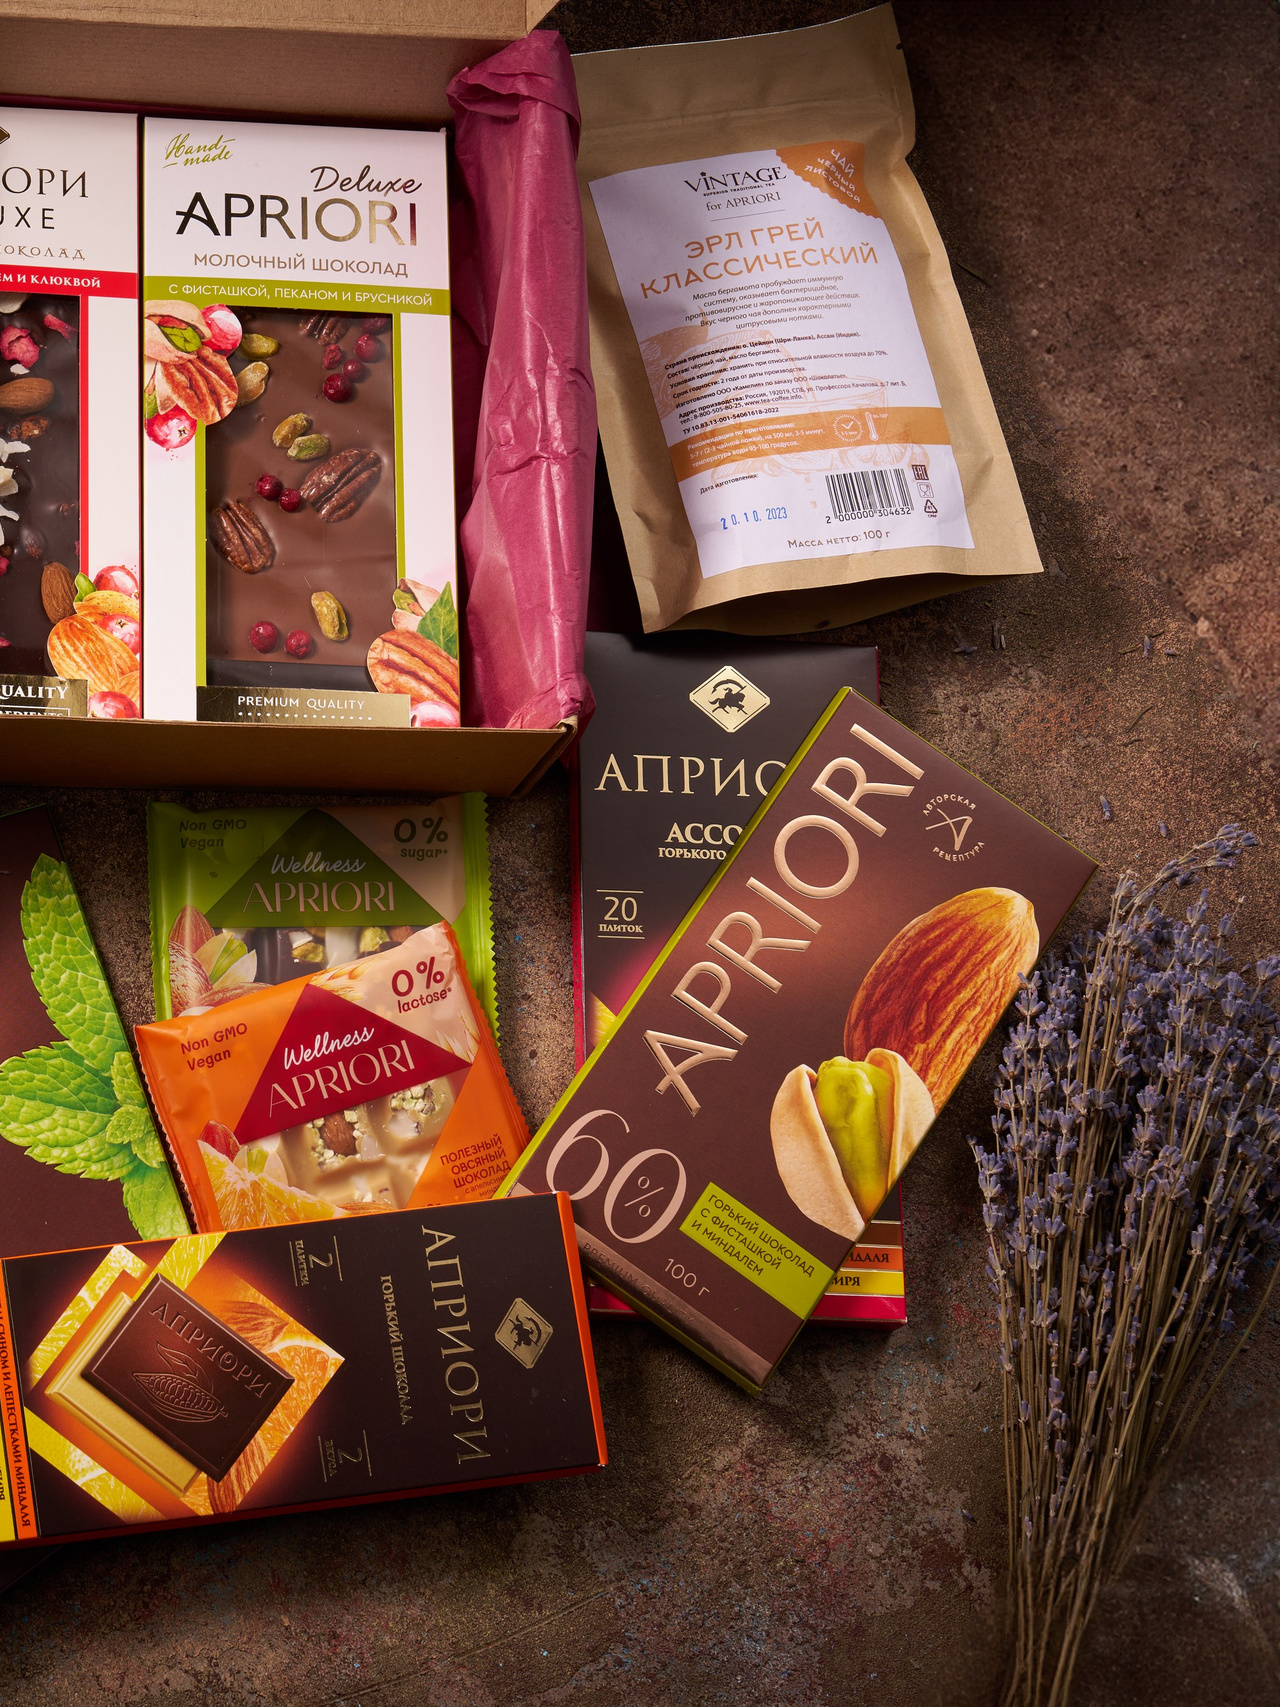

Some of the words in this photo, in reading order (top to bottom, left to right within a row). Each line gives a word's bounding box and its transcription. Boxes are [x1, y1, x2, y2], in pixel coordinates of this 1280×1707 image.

[817, 157, 856, 192] ЧЕРНЫЙ
[830, 148, 855, 178] ЧАЙ
[310, 164, 423, 197] Deluxe
[683, 166, 787, 192] VINTAGE
[703, 189, 729, 197] SUPERIOR
[730, 184, 764, 193] TRADITIONAL
[804, 164, 861, 203] ЛИСТОВОЙ
[706, 201, 722, 211] for
[725, 191, 782, 209] APRIORI
[175, 191, 417, 247] APRIORI
[684, 231, 743, 259] ЭРЛ
[750, 217, 824, 246] ГРЕЙ
[194, 253, 306, 271] МОЛОЧНЫЙ
[312, 258, 409, 278] ШОКОЛАД
[640, 241, 878, 299] КЛАССИЧЕСКИЙ
[17, 273, 27, 283] И
[30, 274, 101, 288] КЛЮКВОЙ
[692, 289, 717, 301] Масло
[718, 283, 760, 297] бергамота
[760, 277, 806, 291] пробуждает
[168, 284, 178, 295] С
[182, 284, 271, 300] ФИСТАШКОЙ,
[274, 287, 338, 301] ПЕКАНОМ
[342, 290, 351, 301] И
[355, 291, 432, 306] БРУСНИКОЙ
[703, 296, 738, 308] систему,
[738, 290, 780, 301] оказывает
[685, 302, 752, 322] противовирусное
[700, 318, 717, 328] Вкус
[717, 313, 748, 324] черного
[762, 305, 797, 316] дополнен
[735, 316, 788, 330] цитрусовыми
[789, 313, 824, 323] нотками.
[699, 484, 714, 495] Дата
[715, 473, 759, 488] изготовления:
[765, 506, 788, 520] 2023
[877, 507, 912, 518] 304632
[863, 529, 882, 540] 100
[238, 696, 299, 707] PREMIUM
[306, 698, 365, 711] QUALITY
[922, 793, 977, 816] АВТОРСКАЯ
[179, 819, 207, 833] Non
[212, 819, 247, 831] GMO
[180, 836, 224, 851] Vegan
[658, 847, 728, 861] ГОРЬКОГО
[932, 841, 985, 862] РЕЦЕПТУРА
[271, 851, 366, 875] Wellness
[242, 881, 395, 913] APRIORI
[603, 896, 638, 922] 20
[599, 924, 644, 933] ПЛИТОК
[641, 723, 925, 1117] APRIORI
[180, 1037, 209, 1055] Non
[213, 1022, 248, 1043] GMO
[283, 1026, 375, 1070] Wellness
[186, 1049, 232, 1072] Vegan
[269, 1039, 416, 1118] APRIORI
[440, 1133, 502, 1166] ПОЛЕЗНЫЙ
[451, 1146, 506, 1175] ОВСЯНЫЙ
[453, 1160, 511, 1189] ШОКОЛАД
[691, 1219, 701, 1231] И
[701, 1228, 764, 1276] МИНДАЛЕМ
[700, 1207, 711, 1219] С
[711, 1214, 782, 1271] ФИСТАШКОЙ
[708, 1194, 760, 1236] ГОРЬКИЙ
[758, 1231, 816, 1278] ШОКОЛАД
[295, 1239, 310, 1286] ПЛИТКИ
[309, 1252, 333, 1269] 2
[664, 1258, 697, 1288] 100
[584, 1242, 638, 1286] PREMIUM
[642, 1284, 695, 1325] QUALITY
[380, 1275, 404, 1343] ГОРЬКИЙ
[149, 1302, 272, 1399] АПРИОРИ
[421, 1225, 491, 1465] АПРИОРИ
[1, 1371, 11, 1381] И
[391, 1345, 414, 1426] ШОКОЛАД
[3, 1382, 22, 1464] ЛЕПЕСТКАМИ
[338, 1447, 363, 1464] 2
[14, 1465, 31, 1527] МИНДАЛЯ
